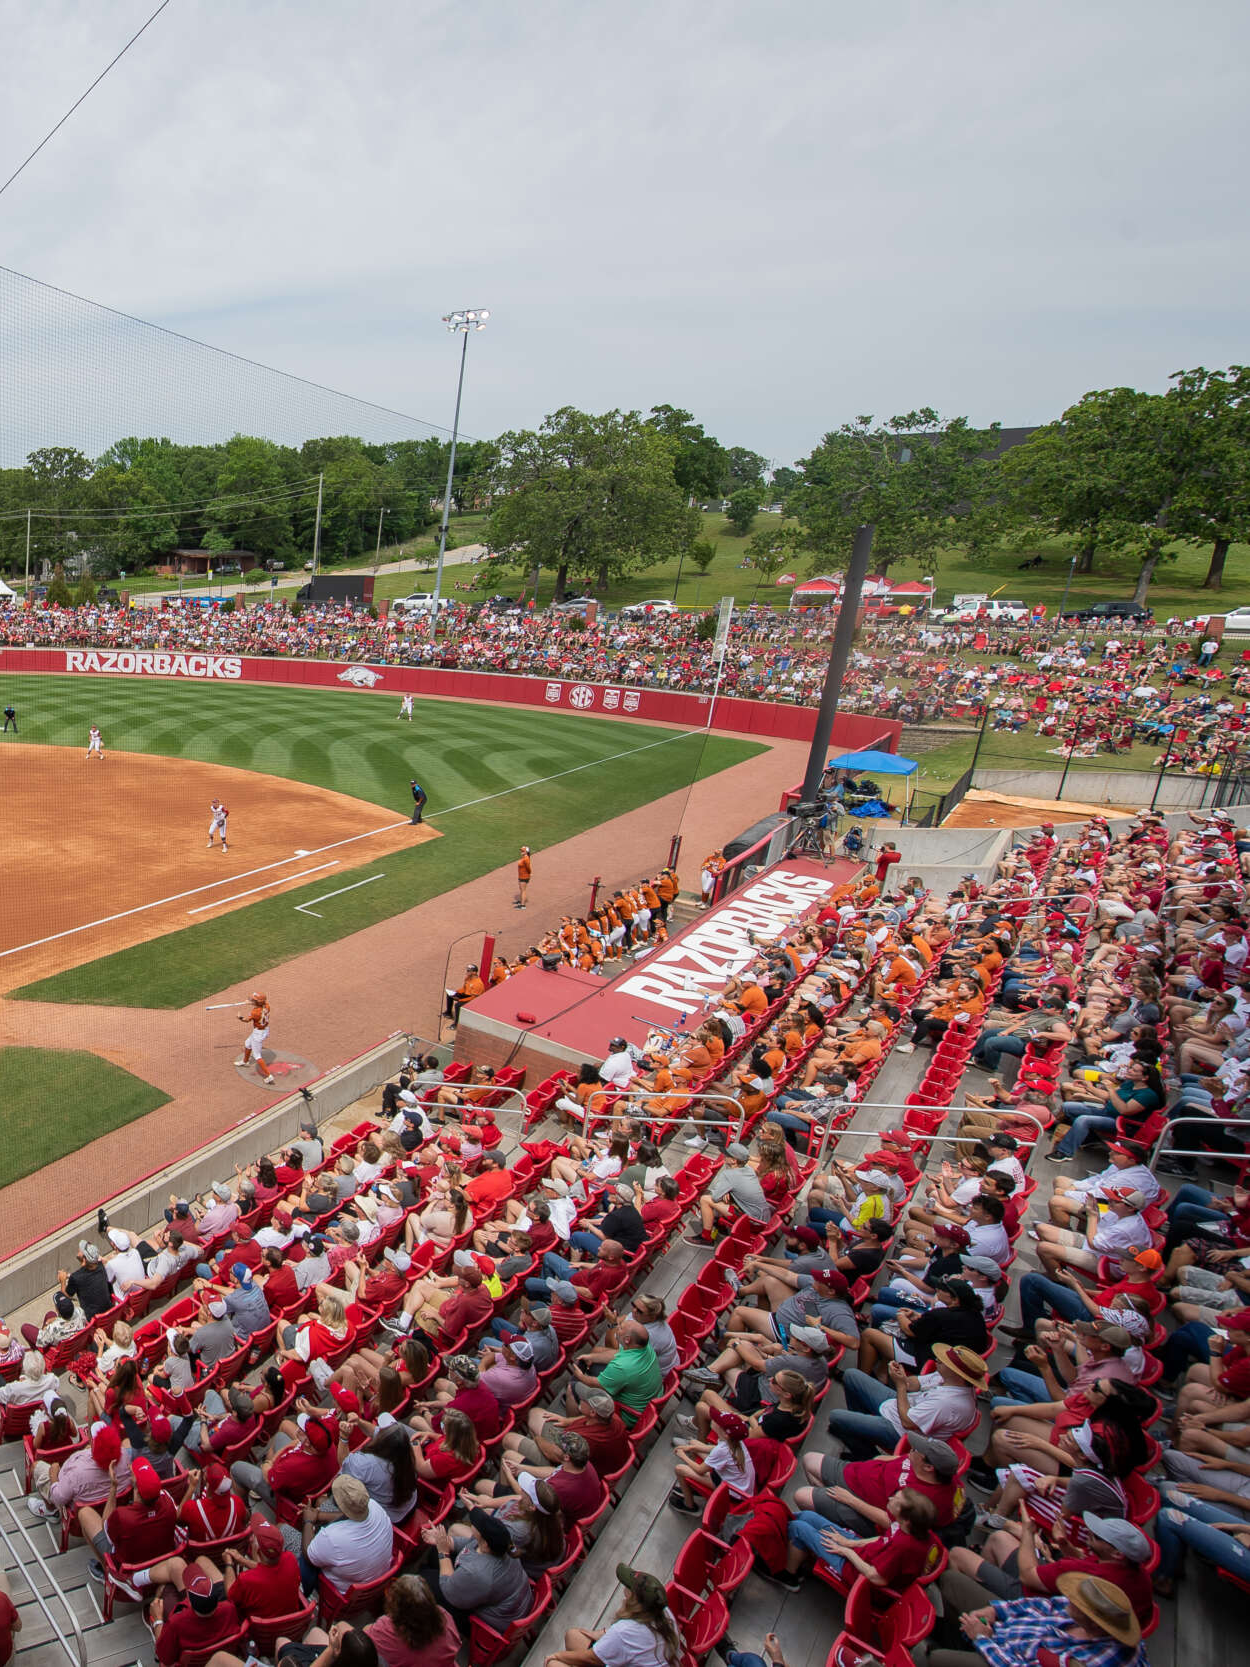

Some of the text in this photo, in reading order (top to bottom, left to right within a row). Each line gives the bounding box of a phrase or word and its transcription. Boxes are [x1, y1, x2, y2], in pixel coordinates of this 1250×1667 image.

[66, 652, 242, 679] RAZORBACKS
[571, 686, 592, 708] SEC
[615, 870, 835, 1014] RAZORBACKS
